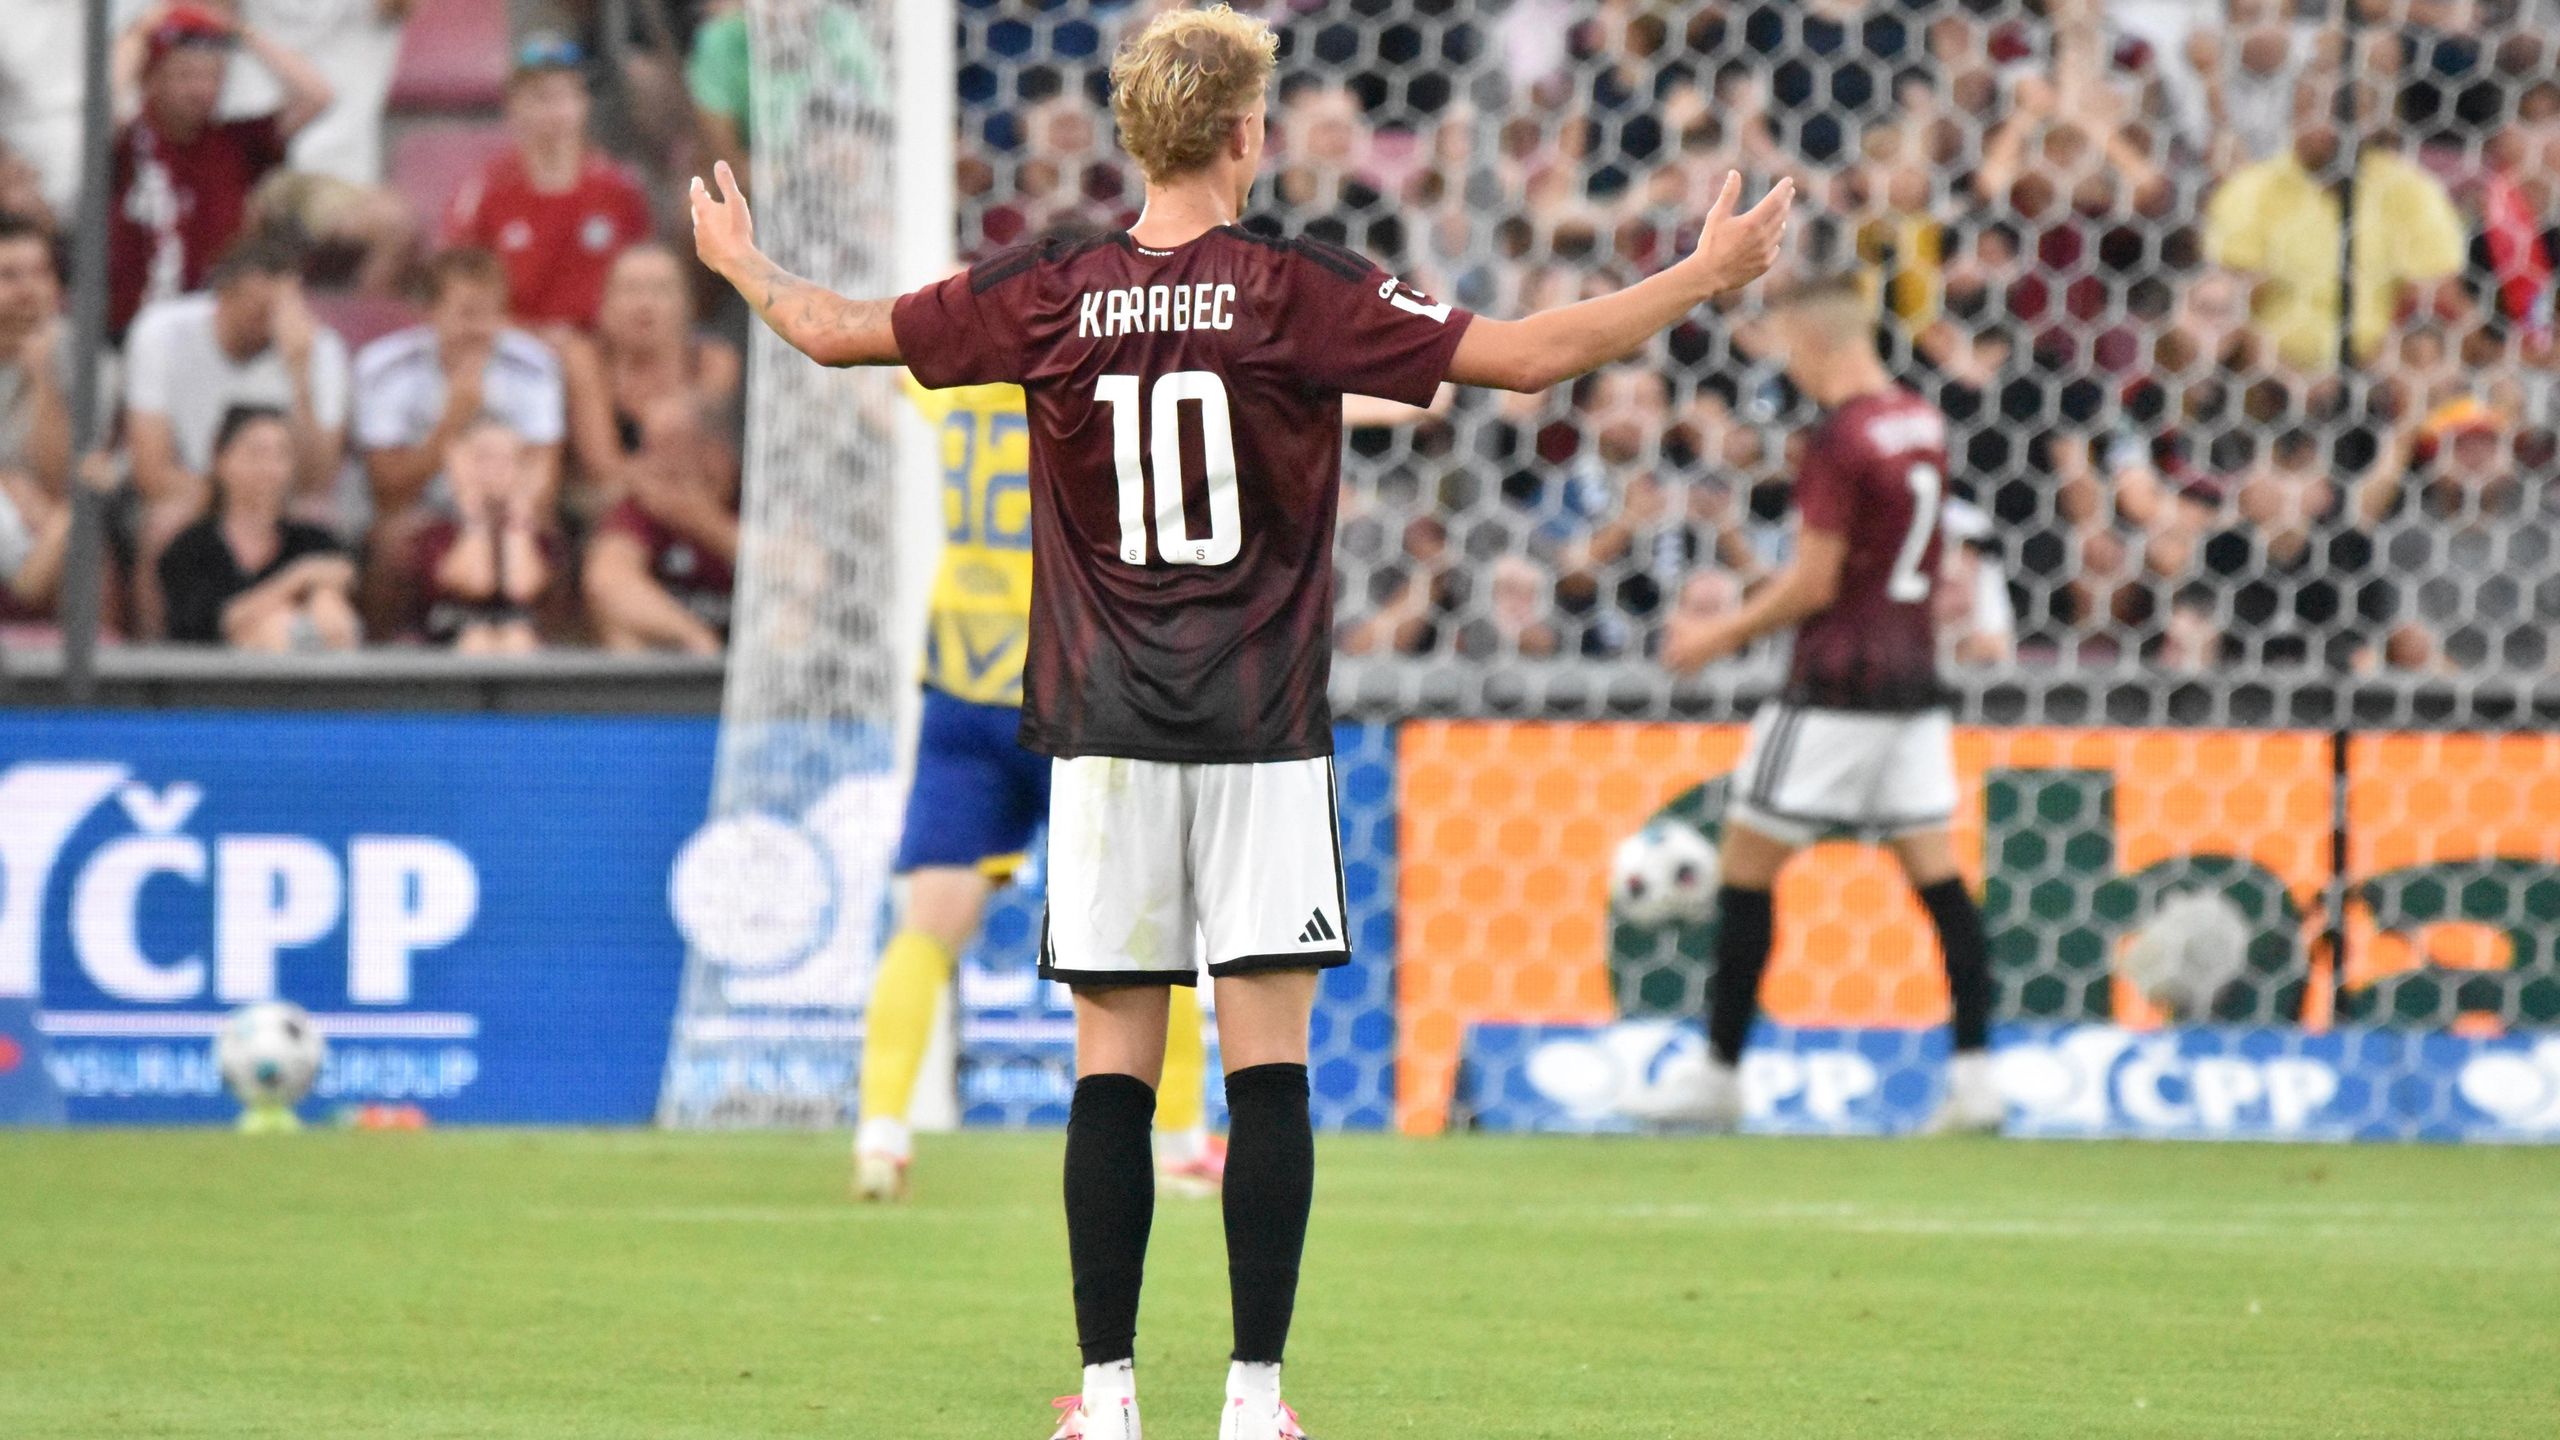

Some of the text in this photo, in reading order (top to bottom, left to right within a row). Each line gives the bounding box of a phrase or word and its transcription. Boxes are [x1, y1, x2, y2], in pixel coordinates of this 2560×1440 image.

[1078, 282, 1236, 338] KARABEC
[1093, 371, 1242, 566] 10
[70, 780, 481, 1004] ČPP
